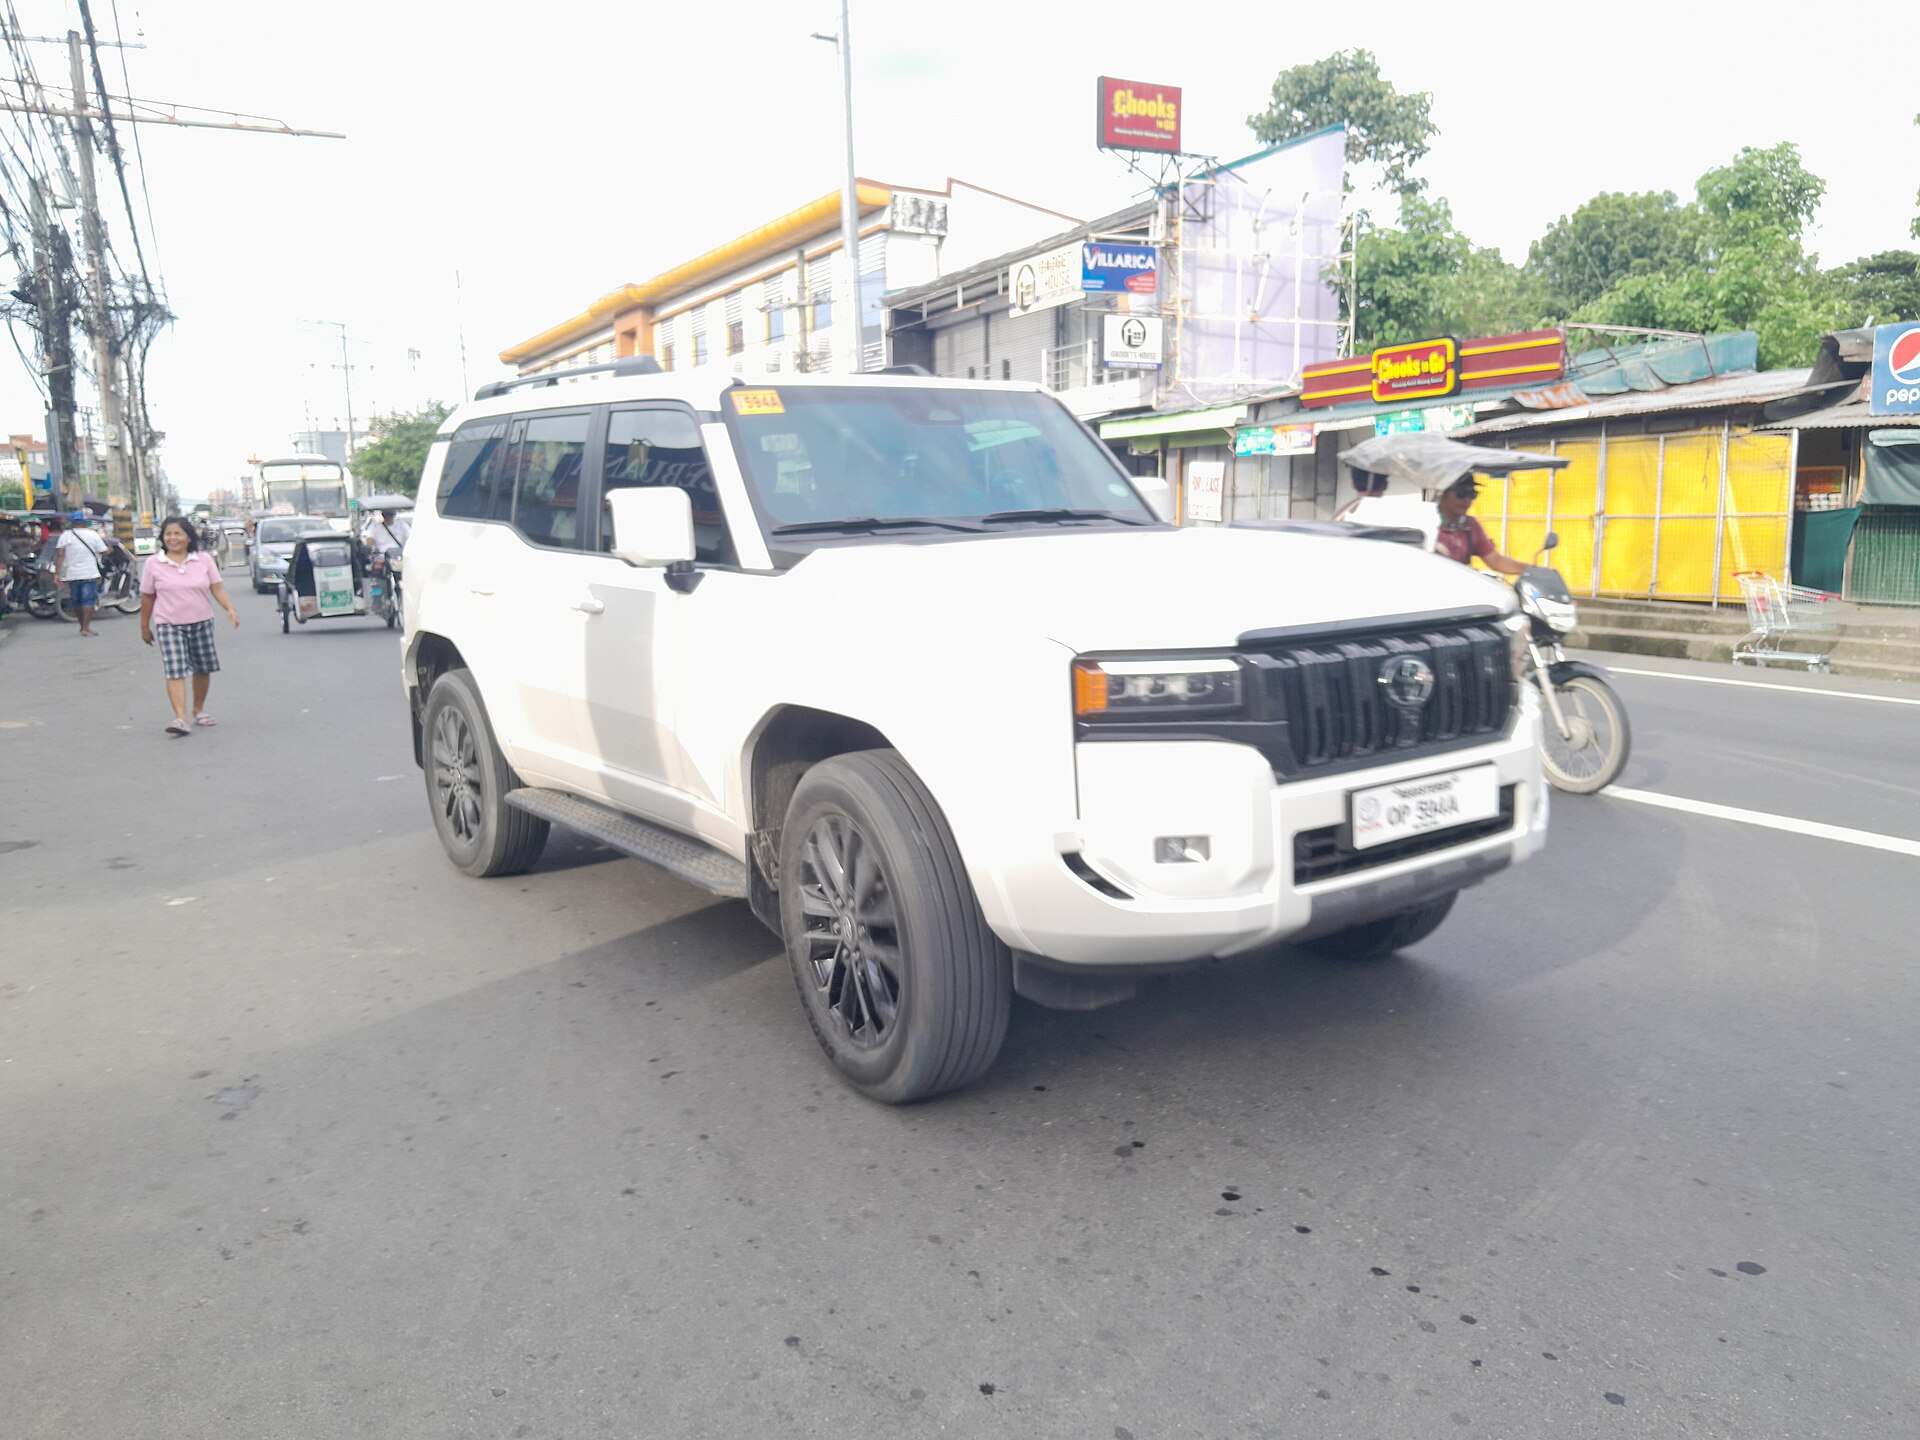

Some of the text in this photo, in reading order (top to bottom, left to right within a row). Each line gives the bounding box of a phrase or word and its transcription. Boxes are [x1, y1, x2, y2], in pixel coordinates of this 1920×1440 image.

[1113, 88, 1176, 120] Chooks
[1083, 246, 1156, 270] VILLARICA
[1377, 354, 1421, 382] Chooks
